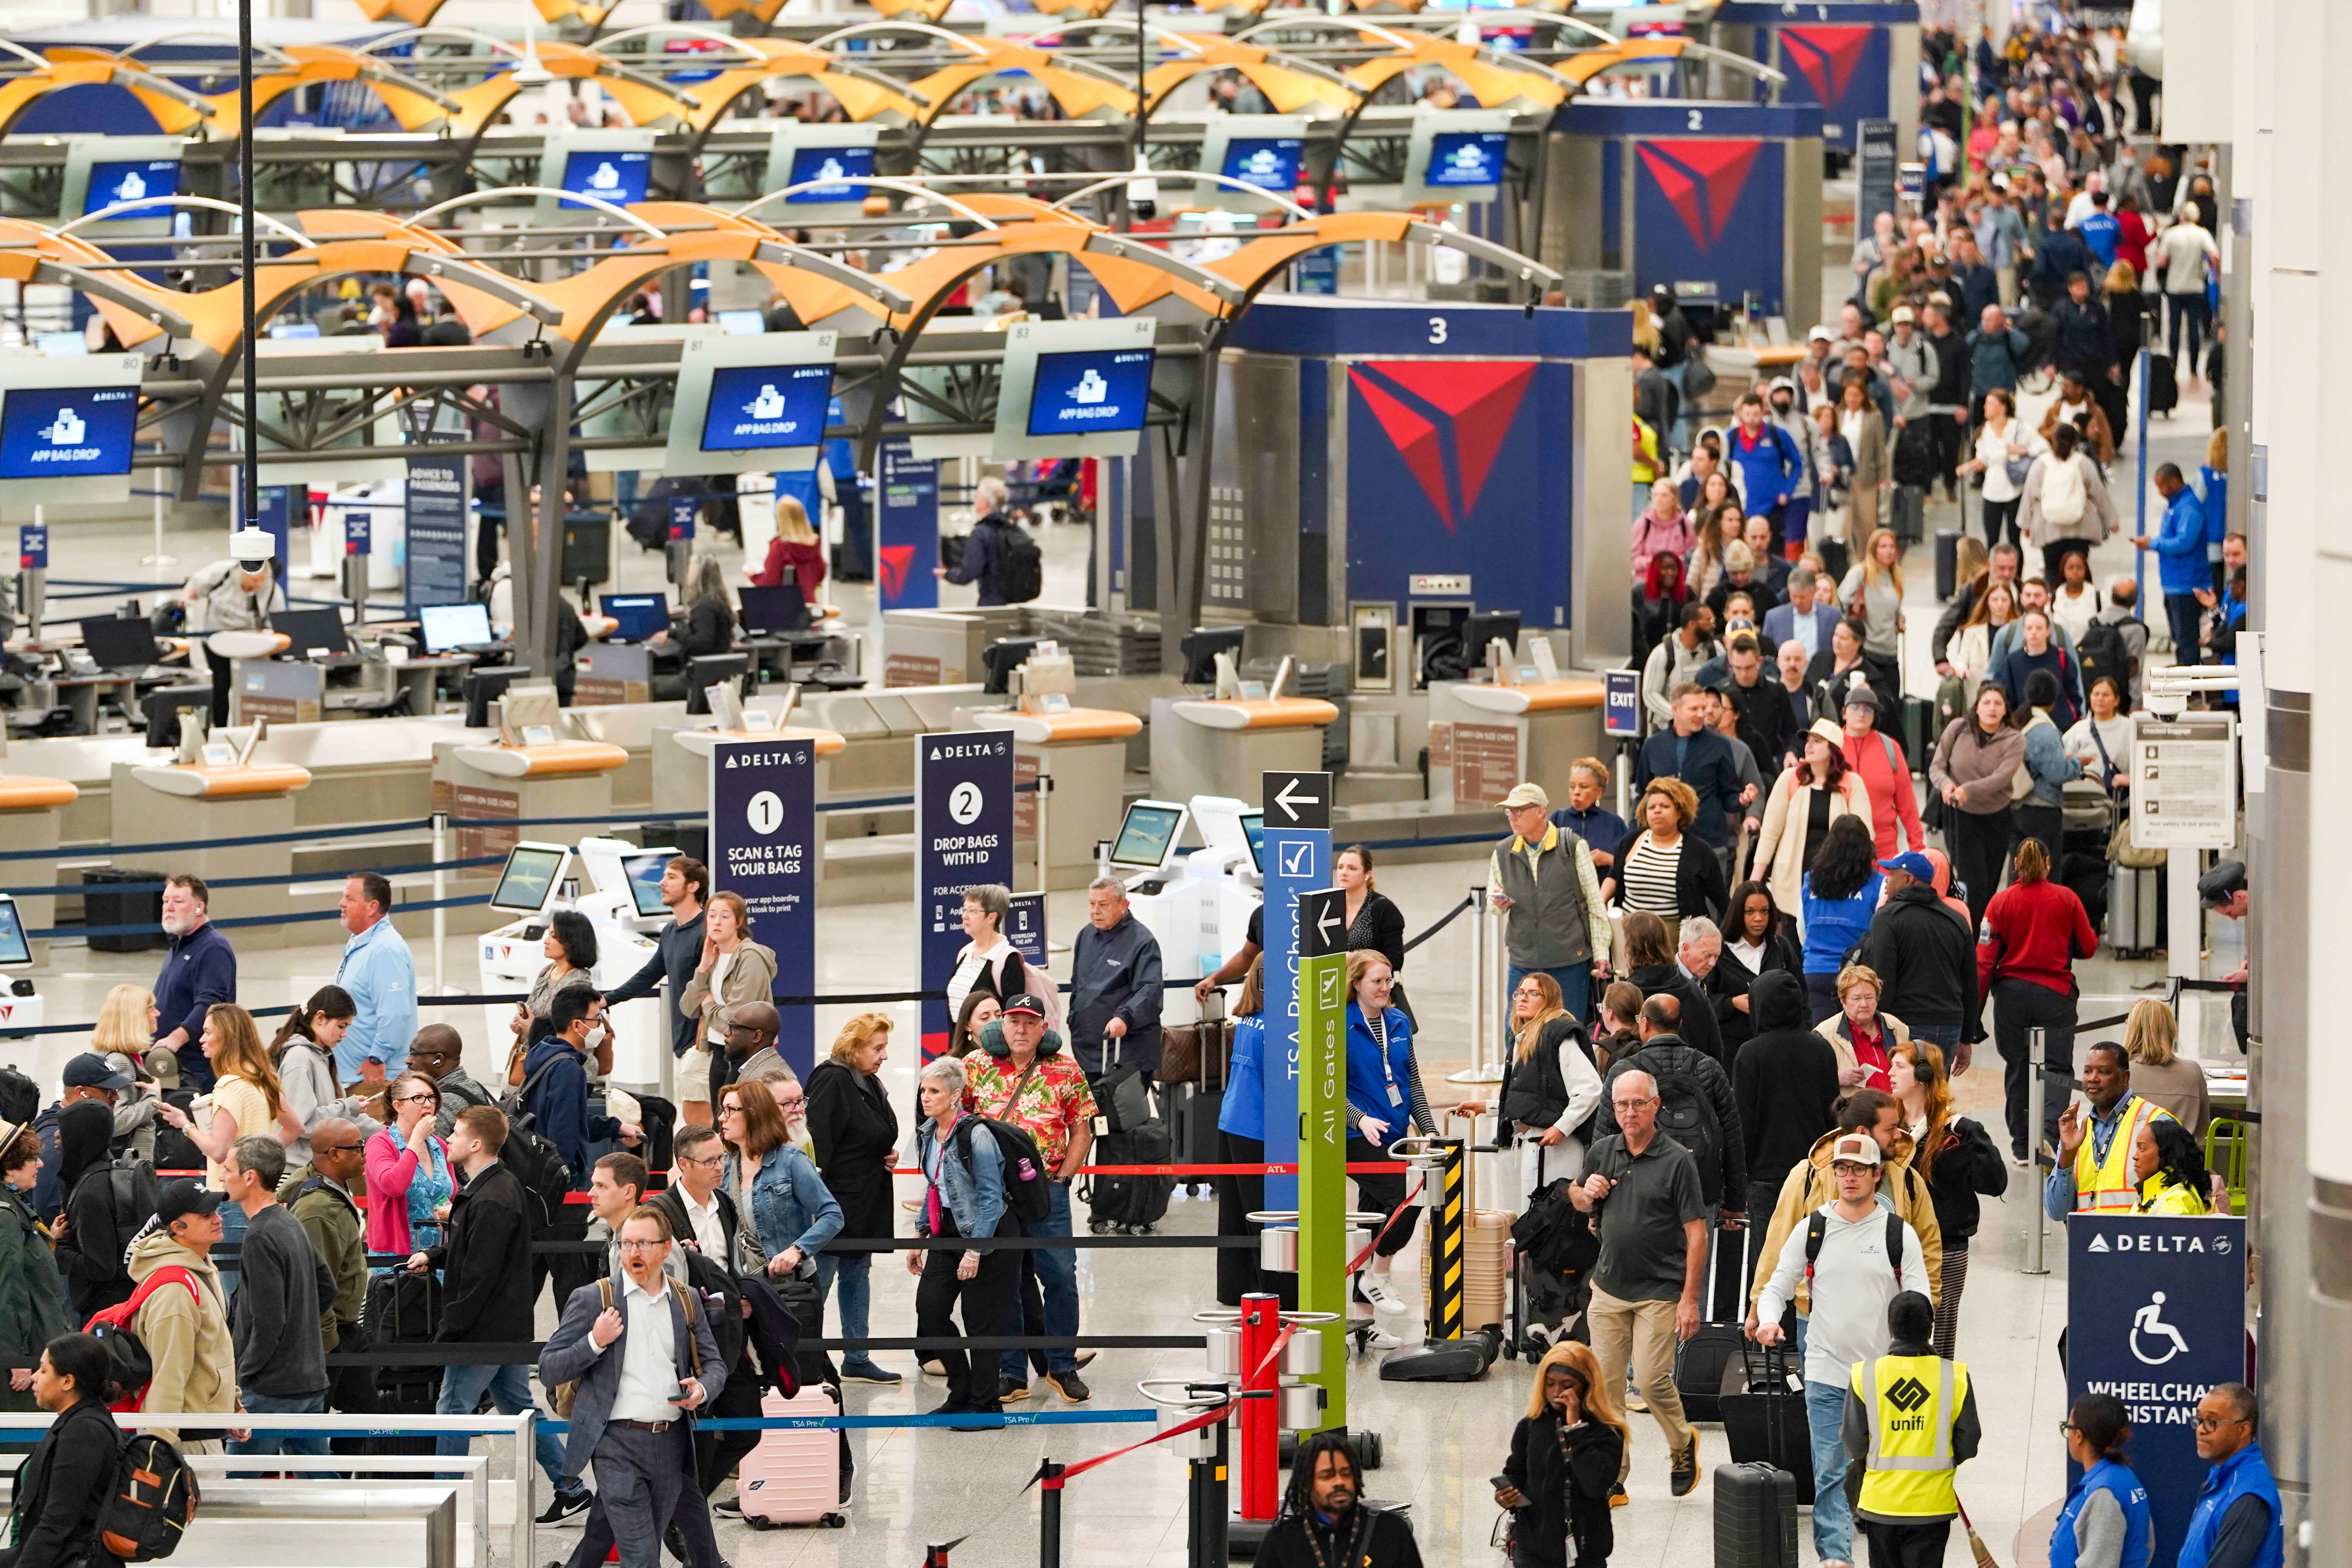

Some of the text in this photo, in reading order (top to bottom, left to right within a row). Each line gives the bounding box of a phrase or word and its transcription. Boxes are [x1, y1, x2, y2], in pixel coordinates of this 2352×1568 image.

[1688, 109, 1702, 131] 2
[1429, 317, 1448, 344] 3
[1058, 408, 1076, 419] APP
[734, 421, 797, 435] APP BAG DROP
[31, 448, 101, 462] APP BAG DROP
[1610, 691, 1635, 708] EXIT
[946, 744, 991, 758] DELTA
[741, 753, 791, 766] DELTA
[960, 791, 972, 816] 2
[760, 800, 769, 825] 1
[934, 834, 998, 851] DROP BAGS
[728, 844, 802, 860] SCAN & TAG
[943, 851, 989, 866] WITH ID
[730, 860, 800, 876] YOUR BAGS
[773, 894, 800, 903] boarding
[934, 887, 948, 896] FOR
[776, 904, 791, 913] print
[1323, 1019, 1335, 1144] All Gates
[2117, 1234, 2205, 1253] DELTA
[2087, 1381, 2215, 1402] WHEELCHA
[1891, 1416, 1924, 1431] unifi
